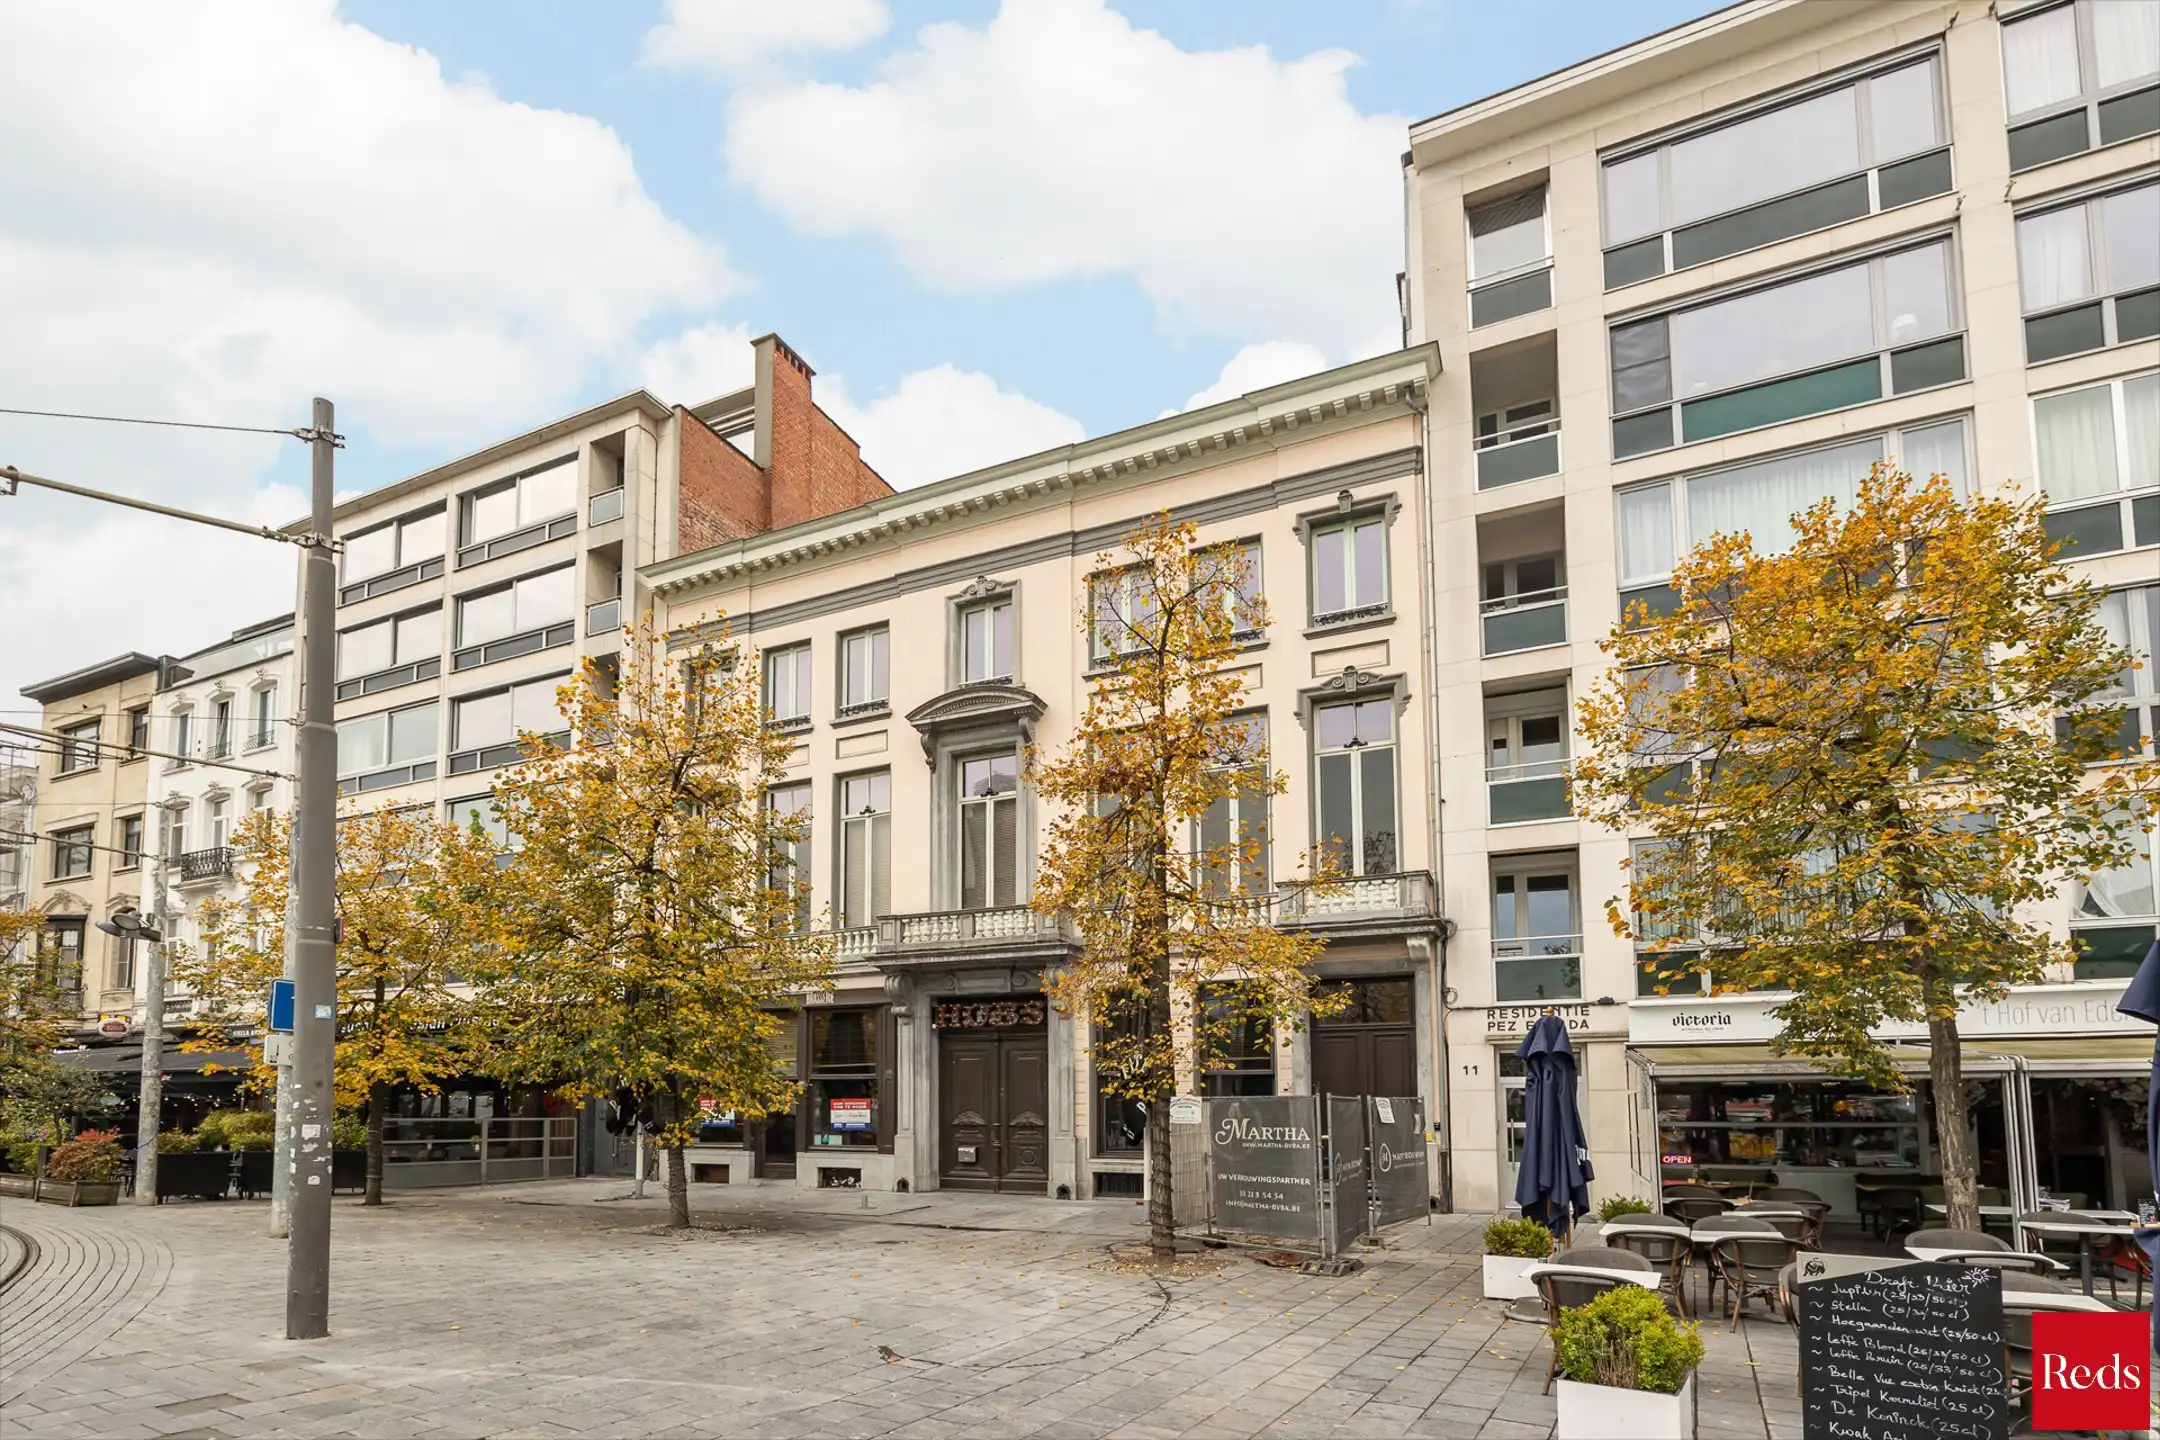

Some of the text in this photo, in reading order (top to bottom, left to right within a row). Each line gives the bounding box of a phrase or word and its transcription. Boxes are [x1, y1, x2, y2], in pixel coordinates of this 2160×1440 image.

[1672, 1011, 1731, 1026] victoria
[1998, 1001, 2033, 1026] Hof
[2039, 1004, 2076, 1024] van
[1487, 1021, 1516, 1032] PEZ
[1462, 1065, 1478, 1076] 11
[1662, 1155, 1692, 1164] OPEN
[1831, 1300, 1871, 1312] Stella
[1828, 1365, 1865, 1381] Belle
[1873, 1373, 1895, 1385] Vue
[1831, 1400, 1856, 1416] De
[1867, 1404, 1930, 1429] Koninck
